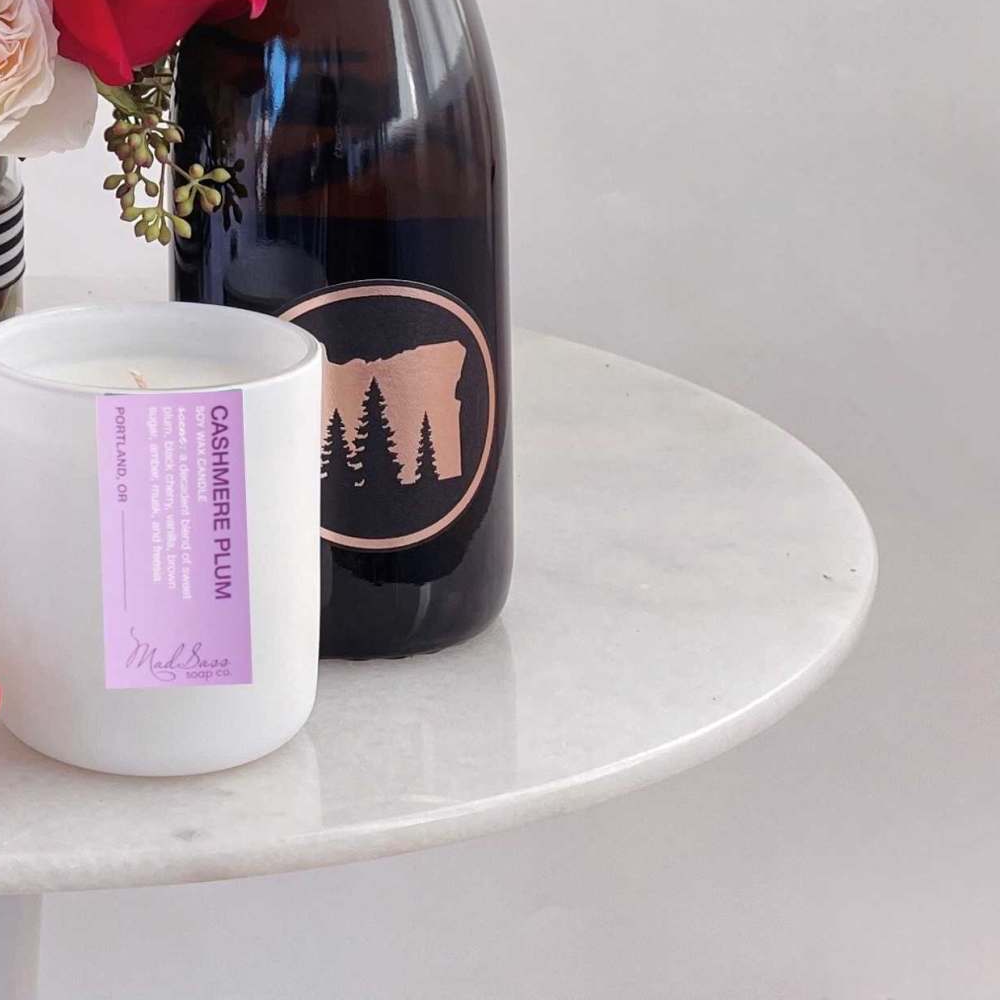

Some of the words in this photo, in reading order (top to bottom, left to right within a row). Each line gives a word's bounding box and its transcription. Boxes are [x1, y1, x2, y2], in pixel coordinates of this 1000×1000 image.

[195, 406, 207, 428] SOY
[115, 407, 127, 480] PORTLAND,
[165, 441, 175, 471] black
[196, 430, 208, 456] WAX
[197, 458, 209, 502] CANDLE
[211, 405, 231, 531] CASHMERE
[117, 484, 127, 502] OR
[152, 522, 161, 543] and
[181, 519, 191, 550] blend
[168, 555, 177, 589] brown
[182, 552, 192, 564] of
[213, 538, 232, 600] PLUM
[182, 567, 192, 600] sweet
[186, 669, 213, 682] soap
